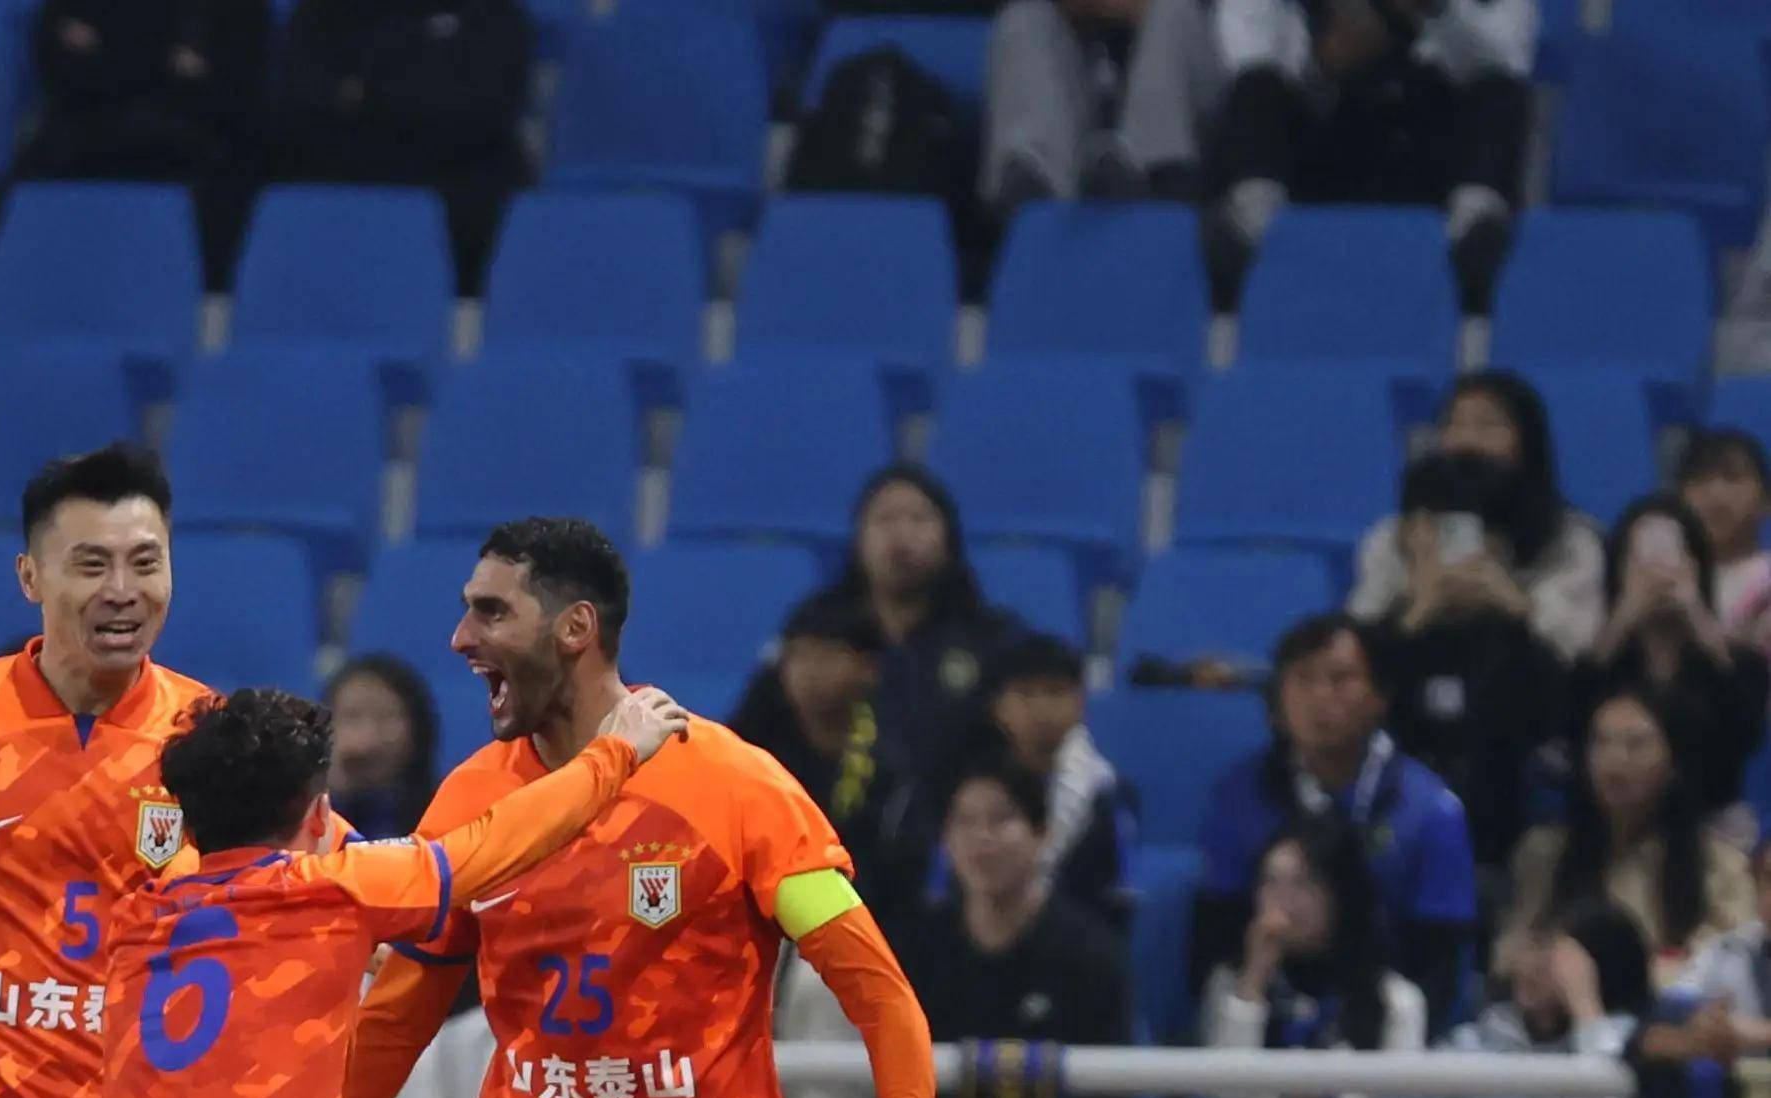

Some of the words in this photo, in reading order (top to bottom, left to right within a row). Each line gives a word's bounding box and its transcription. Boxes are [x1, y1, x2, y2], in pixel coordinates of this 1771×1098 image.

[61, 881, 100, 959] 5
[140, 906, 239, 1071] 6
[538, 953, 613, 1035] 25
